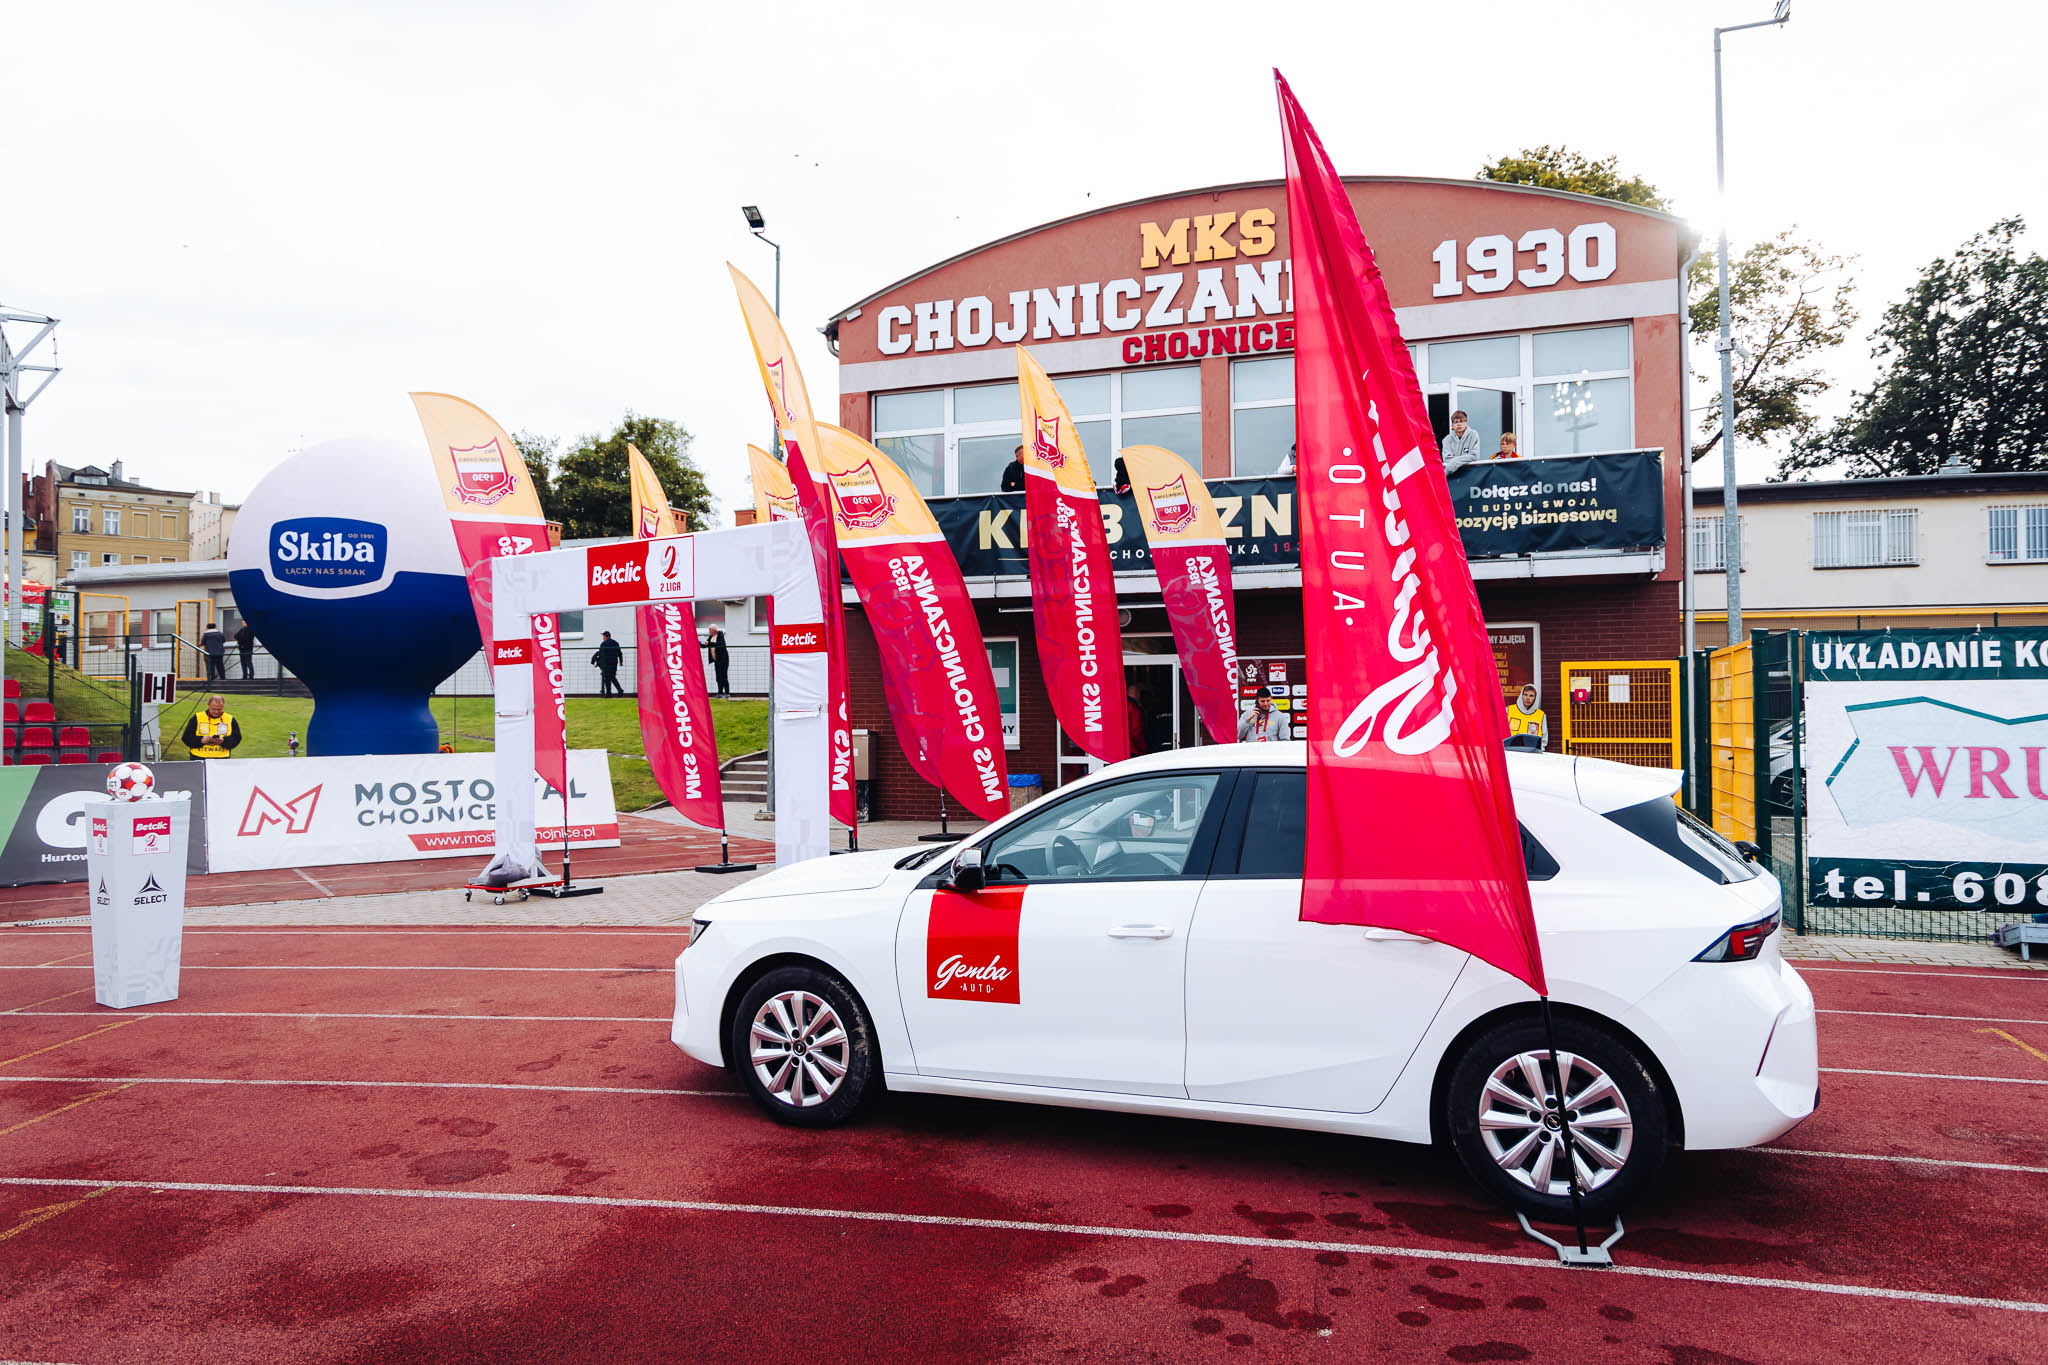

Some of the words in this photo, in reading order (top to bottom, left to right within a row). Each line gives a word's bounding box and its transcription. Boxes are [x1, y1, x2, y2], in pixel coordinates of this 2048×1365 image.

[1140, 208, 1276, 269] MKS
[1432, 222, 1617, 298] 1930
[877, 259, 1294, 355] CHOJNICZAN
[1122, 320, 1295, 364] CHOJNICE
[1469, 483, 1529, 500] Dołącz
[1531, 481, 1554, 496] do
[1557, 477, 1598, 493] nas!
[1482, 502, 1533, 513] BUDUJ
[1542, 498, 1599, 508] SWOJĄ
[1521, 508, 1618, 526] biznesową
[978, 504, 1124, 549] KB
[277, 530, 375, 562] Skiba
[285, 567, 312, 576] ŁĄCZY
[315, 567, 335, 575] NAS
[337, 568, 366, 576] SMAK
[592, 560, 642, 586] Betclic
[660, 583, 665, 592] 2
[666, 581, 681, 591] LIGA
[781, 632, 817, 646] Betclic
[497, 648, 523, 660] Betclic
[1811, 640, 2002, 670] UKŁADANIE
[152, 676, 166, 700] H
[1887, 745, 2048, 800] WRU
[135, 821, 167, 832] Betclic
[358, 803, 496, 827] CHOJNICE
[41, 854, 88, 863] Hurtow
[1824, 868, 1931, 902] tel.
[133, 894, 167, 906] SELECT
[934, 954, 1013, 991] Gemba
